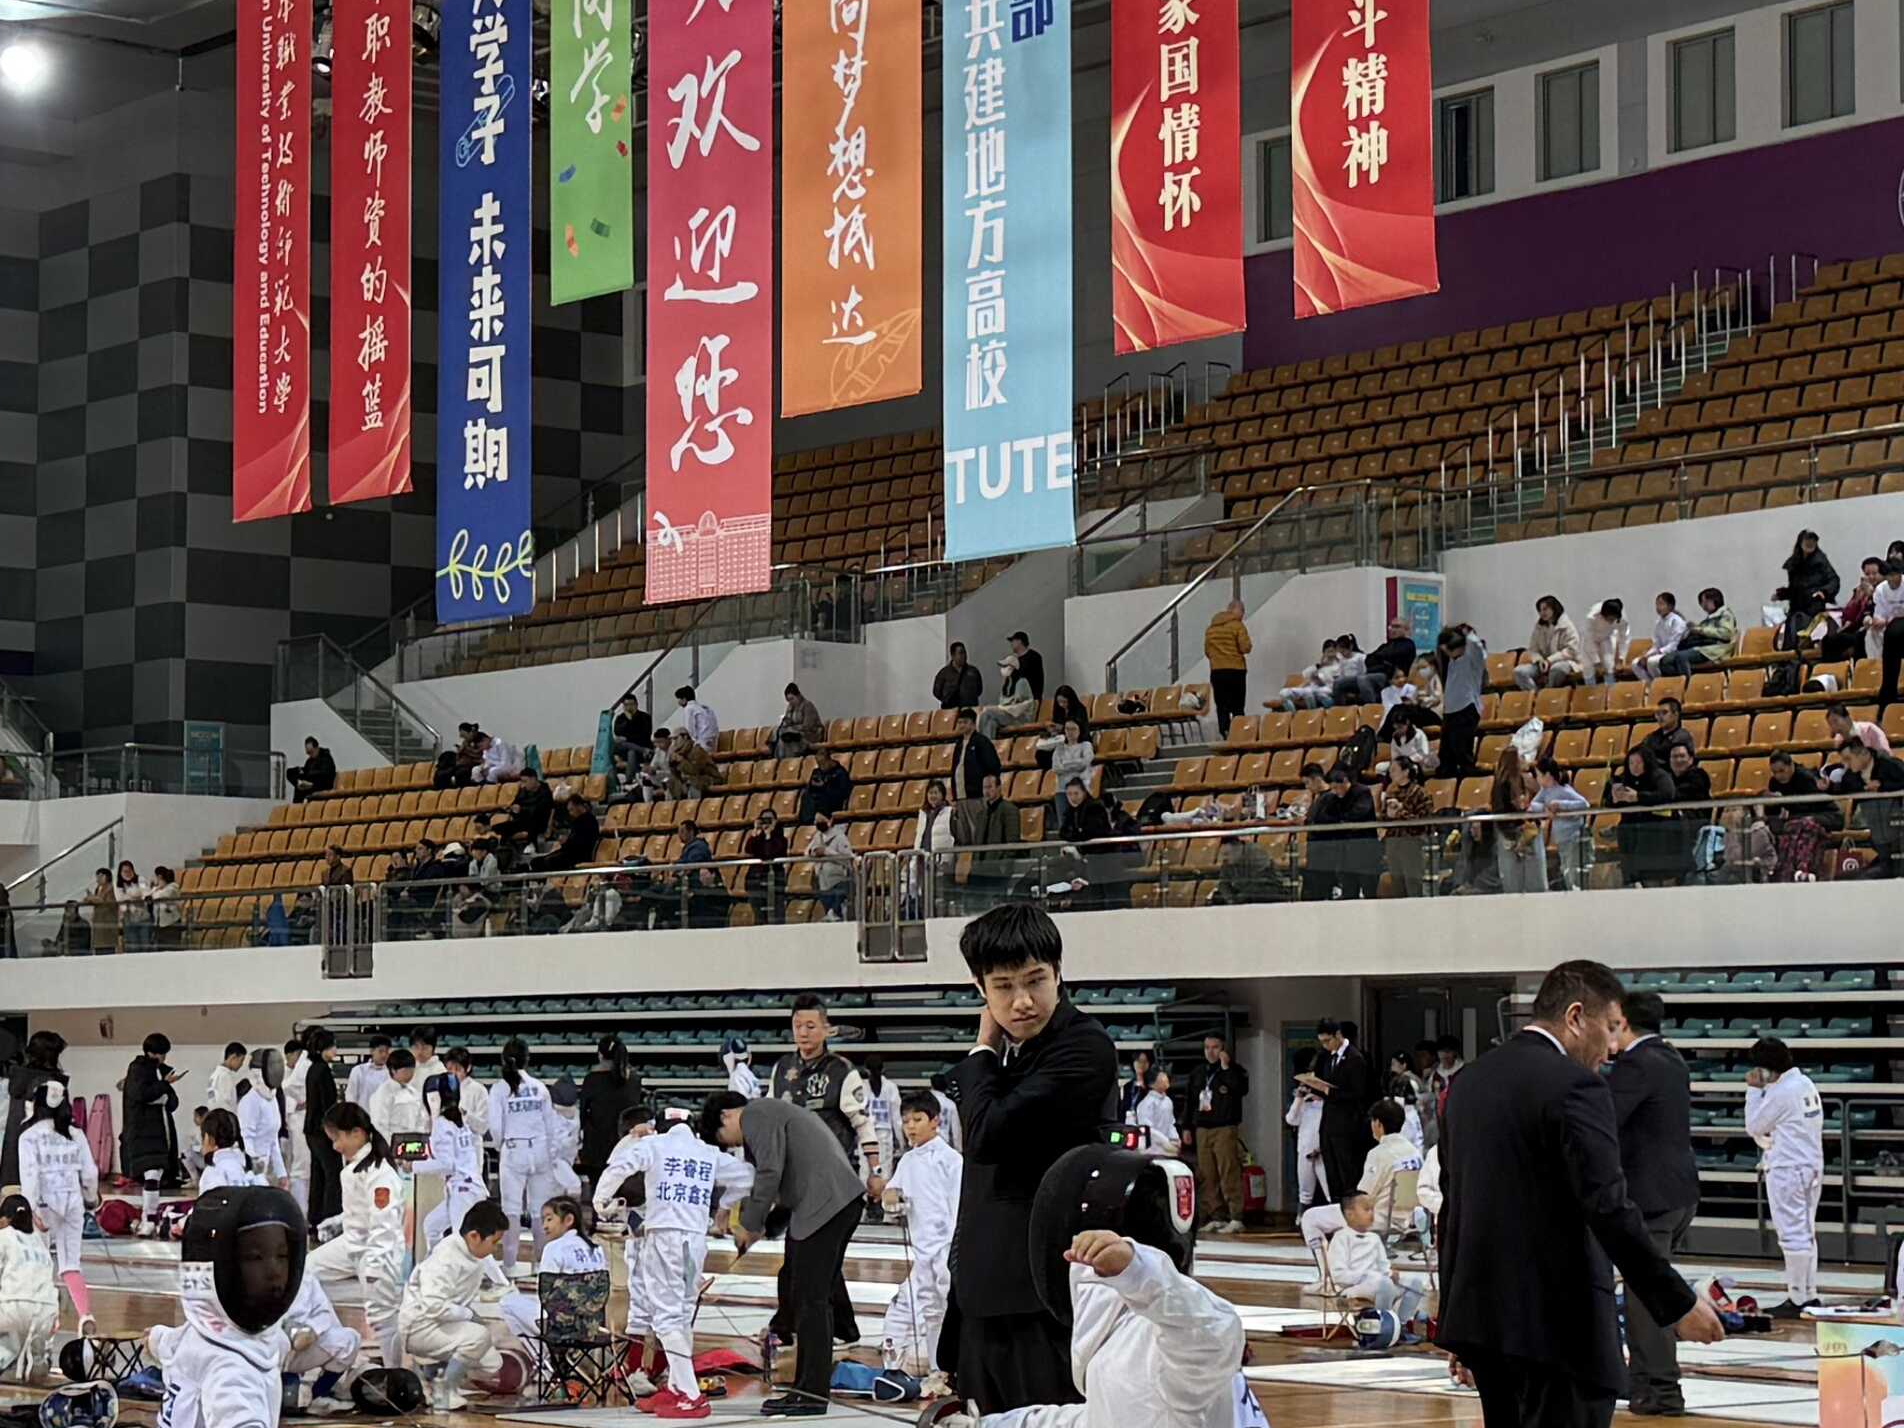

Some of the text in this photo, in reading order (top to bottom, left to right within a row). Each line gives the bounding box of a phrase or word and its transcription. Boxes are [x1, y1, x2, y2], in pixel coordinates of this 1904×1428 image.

[259, 17, 273, 119] University
[260, 123, 272, 143] of
[257, 146, 273, 266] Technology
[259, 271, 270, 309] and
[663, 48, 761, 473] 欢迎您
[258, 312, 271, 414] Education
[463, 191, 509, 490] 未来可期
[945, 430, 1073, 505] TUTE
